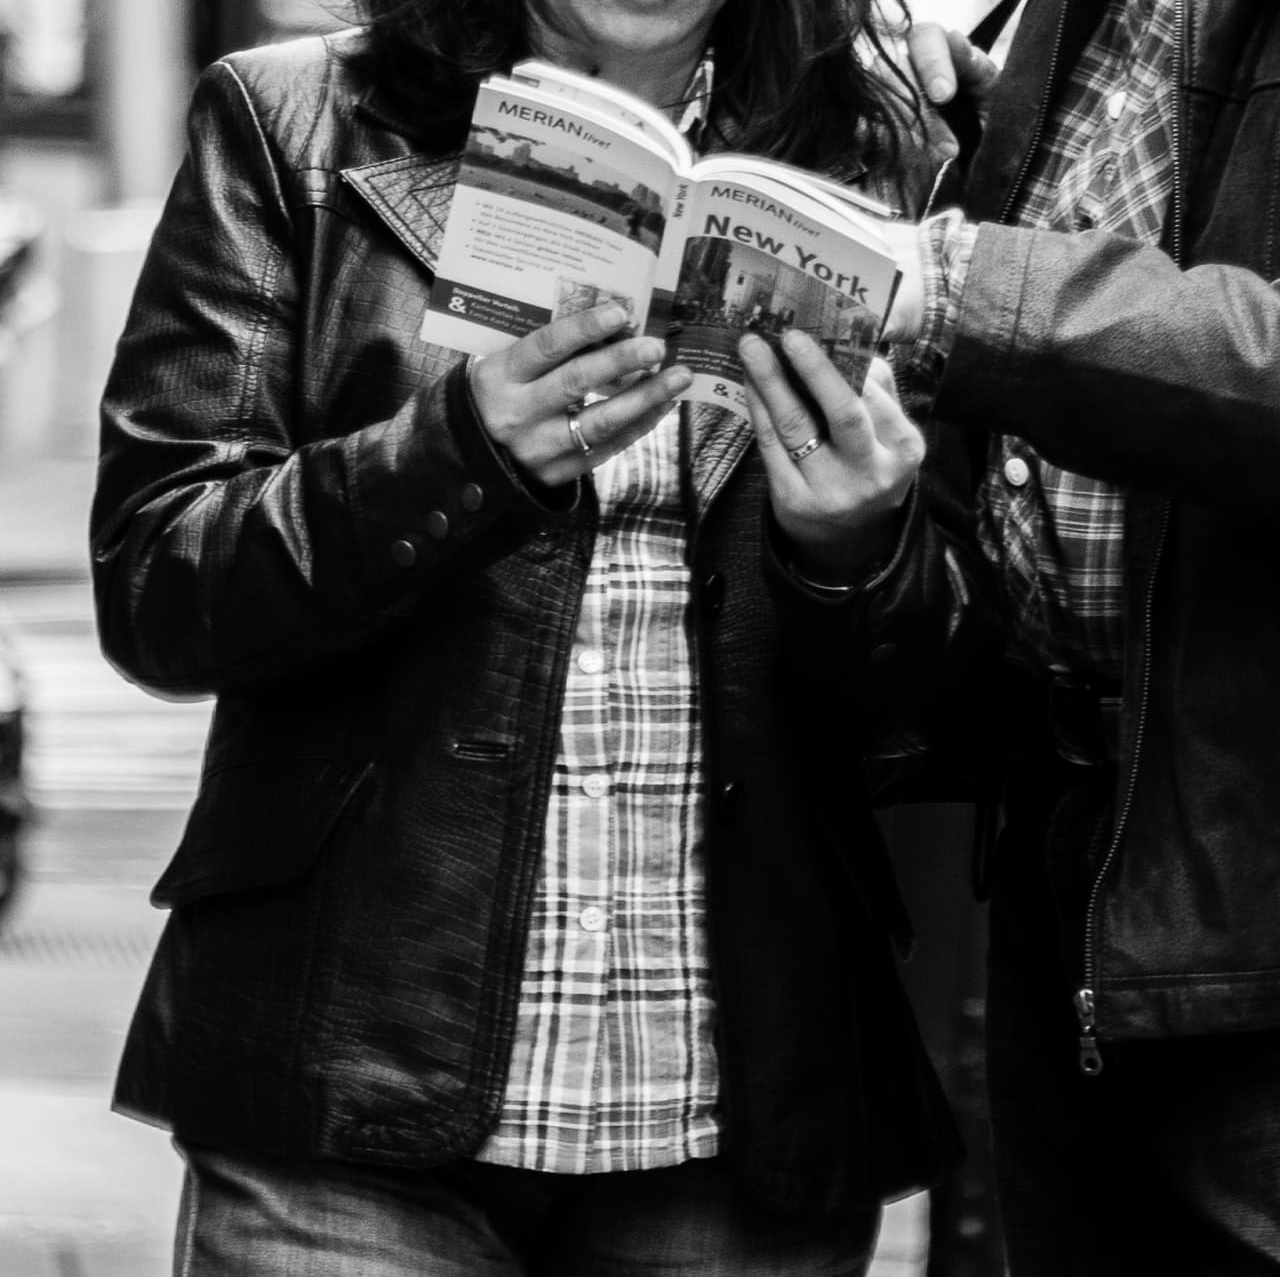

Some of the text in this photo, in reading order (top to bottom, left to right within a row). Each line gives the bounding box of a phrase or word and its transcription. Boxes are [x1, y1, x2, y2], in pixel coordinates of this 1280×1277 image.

[498, 101, 582, 137] MERIAN
[710, 186, 793, 224] MERIAN
[704, 214, 869, 305] New York
[448, 296, 467, 315] &
[713, 383, 729, 399] &
